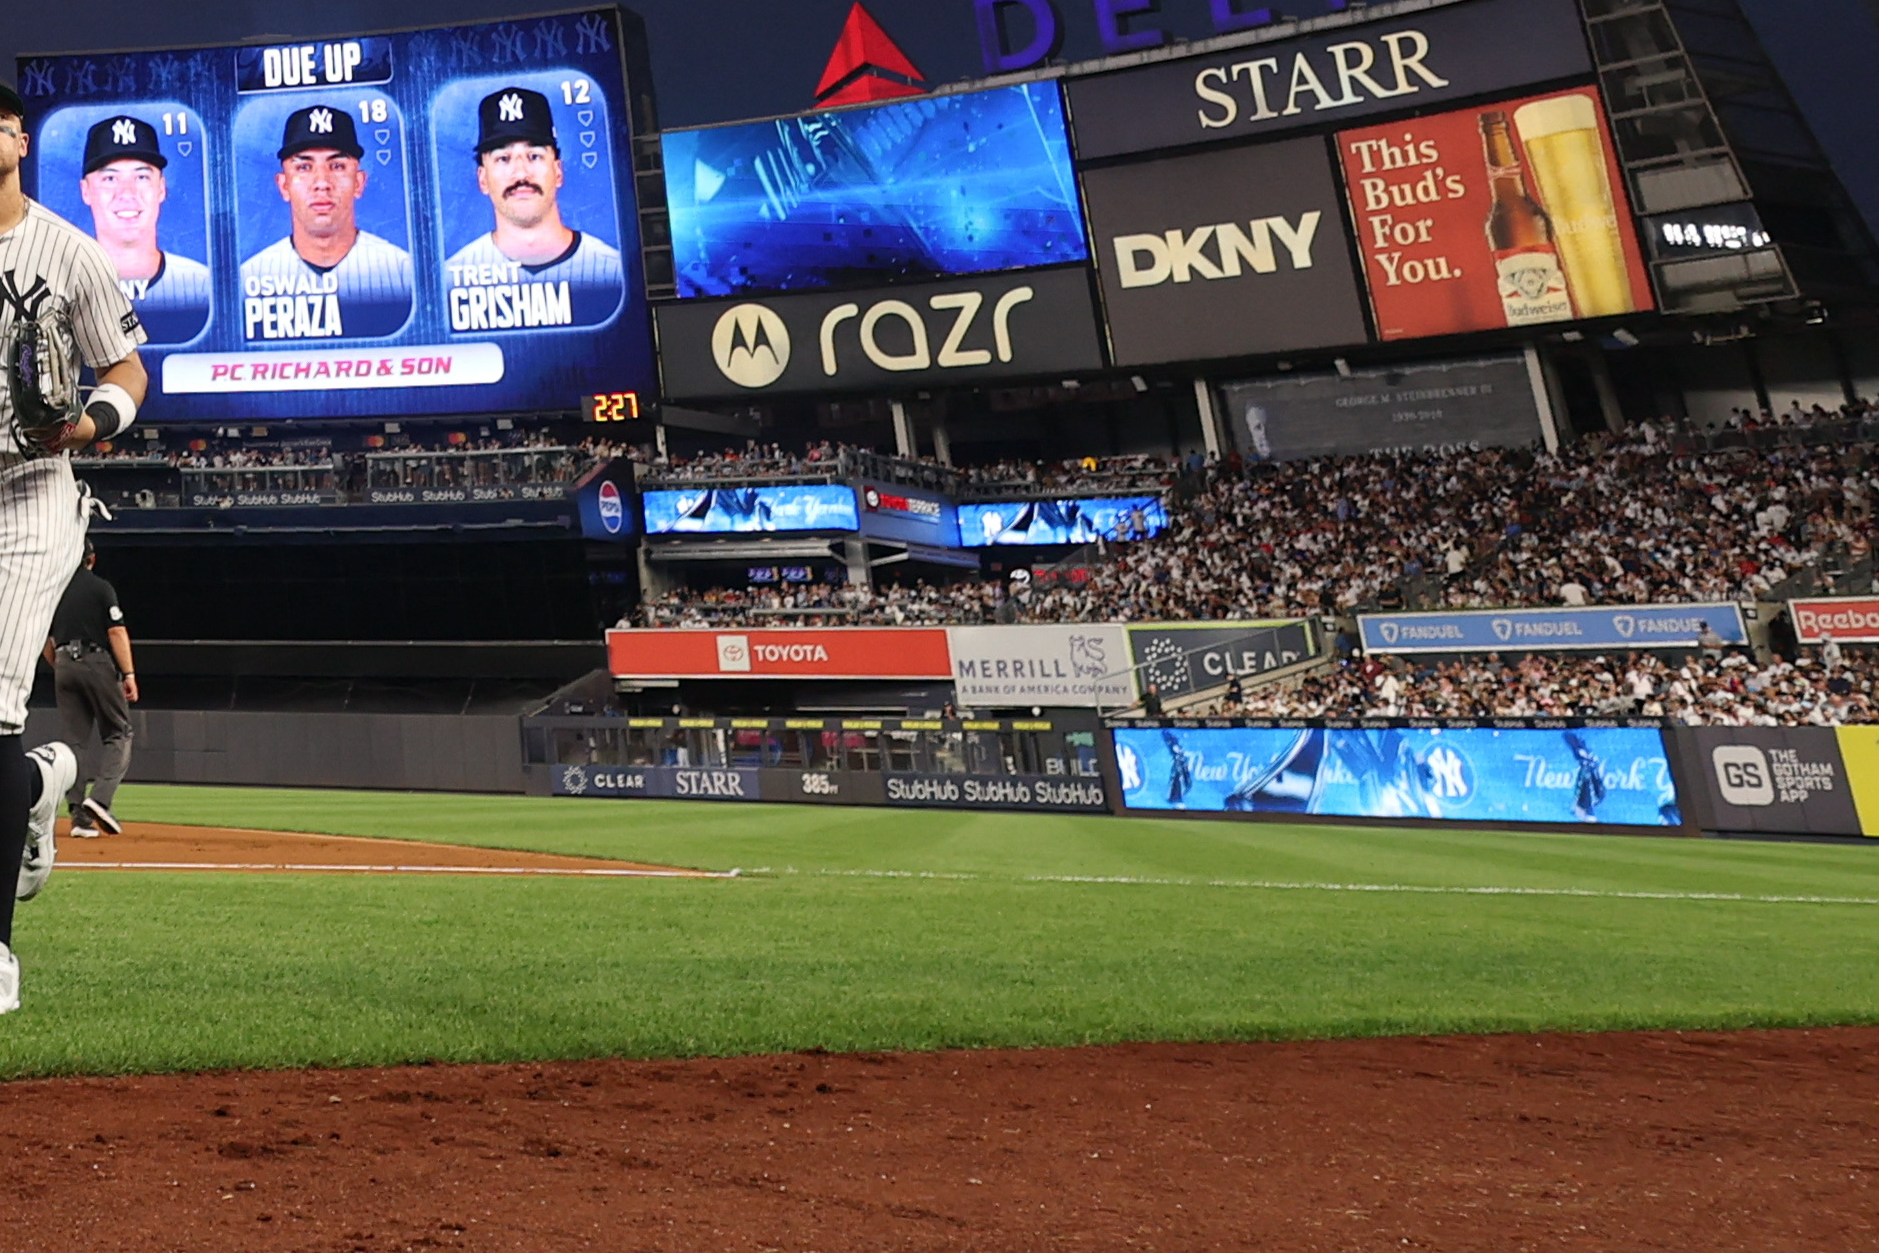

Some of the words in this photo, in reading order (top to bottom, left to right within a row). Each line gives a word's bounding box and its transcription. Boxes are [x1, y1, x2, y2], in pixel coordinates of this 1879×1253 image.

[264, 48, 320, 88] DUE
[324, 42, 362, 84] UP
[1194, 29, 1449, 129] STARR
[561, 79, 591, 105] 12
[162, 112, 188, 136] 11
[358, 99, 388, 124] 18
[1351, 133, 1439, 174] This
[1359, 171, 1466, 212] Bud's
[1368, 218, 1433, 249] For
[1113, 211, 1321, 289] DKNY
[448, 262, 520, 287] TRENT
[1375, 253, 1462, 287] You.
[245, 273, 339, 297] OSWALD
[245, 297, 342, 340] PERAZA
[449, 282, 572, 332] GRISHAM
[121, 315, 139, 330] STA
[820, 286, 1033, 376] razr
[251, 358, 373, 381] RICHARD
[376, 357, 393, 376] &
[400, 356, 453, 376] SON
[593, 393, 638, 422] 2:27
[1401, 624, 1464, 640] FANDUEL
[1515, 621, 1583, 637] FANDUEL
[1798, 609, 1879, 633] Reebo
[754, 643, 829, 663] TOYOTA
[958, 659, 1067, 680] MERRILL
[961, 685, 969, 695] A
[972, 685, 1000, 695] BANK
[1003, 685, 1017, 695] OF
[1020, 685, 1070, 695] AMERICA
[1072, 684, 1129, 696] COMPANY
[1183, 750, 1228, 782] New
[1768, 749, 1799, 764] THE
[594, 773, 646, 789] CLEAR
[1427, 747, 1468, 797] NY
[1723, 762, 1763, 788] GS
[1773, 762, 1835, 777] GOTHAM
[675, 770, 744, 797] STARR
[887, 778, 959, 801] StubHub
[964, 780, 1031, 803] StubHub
[1035, 781, 1104, 805] StubHub
[1776, 776, 1833, 790] SPORTS
[1780, 789, 1809, 803] APP
